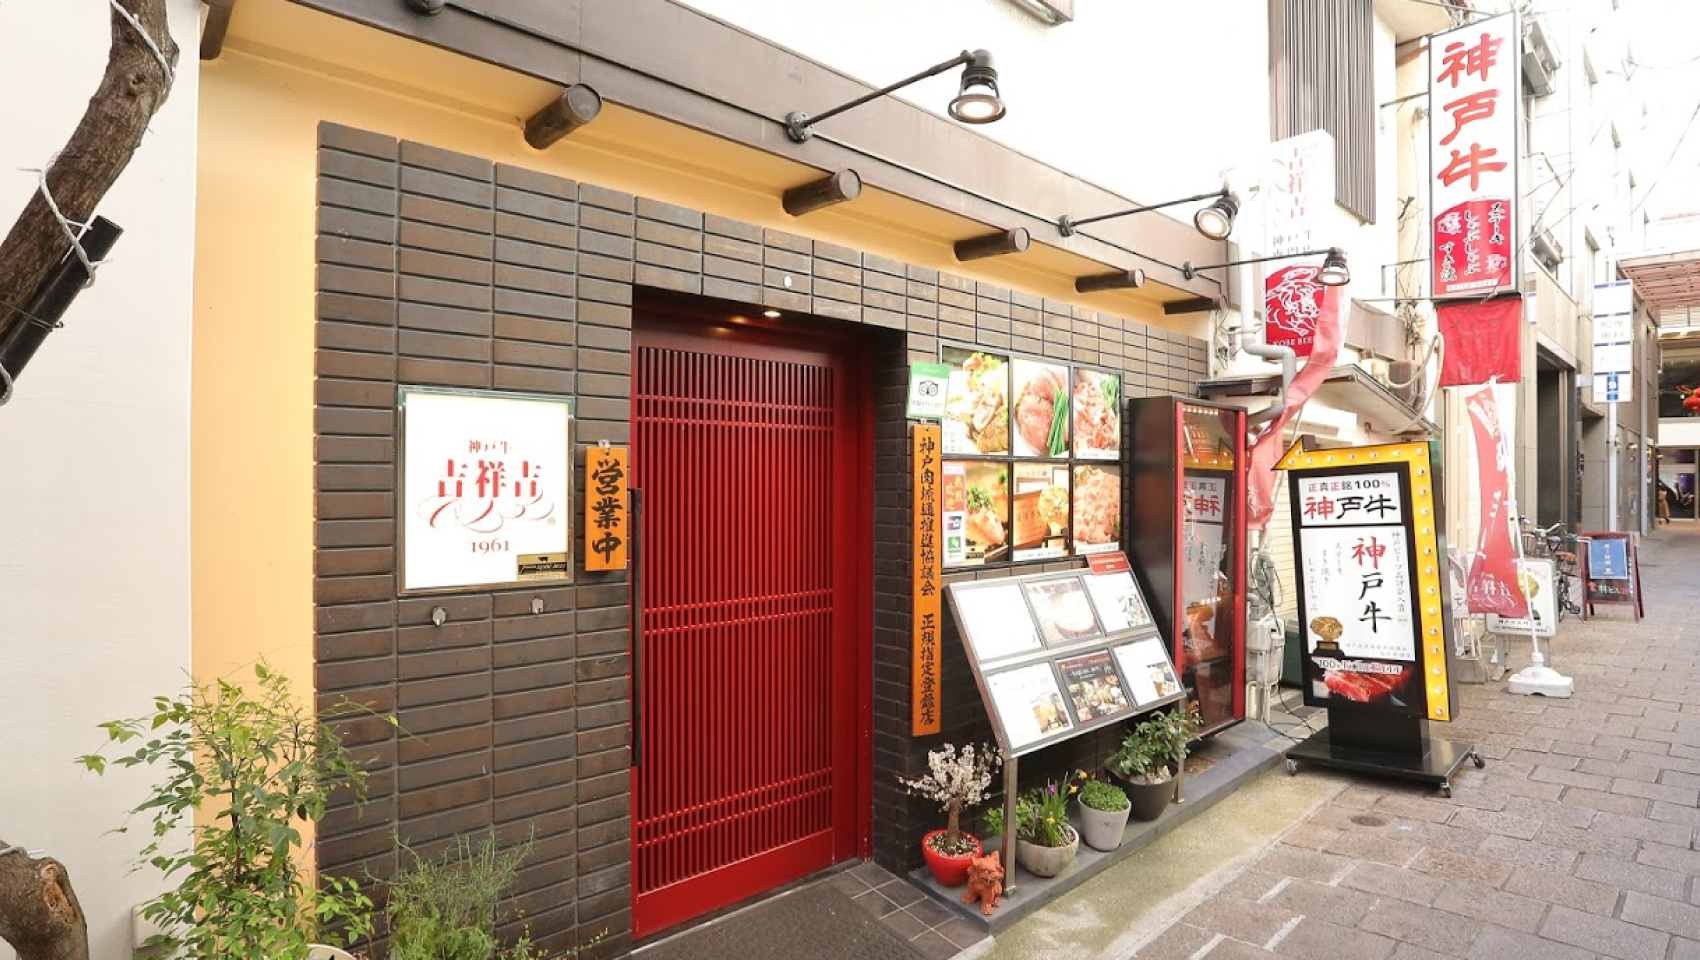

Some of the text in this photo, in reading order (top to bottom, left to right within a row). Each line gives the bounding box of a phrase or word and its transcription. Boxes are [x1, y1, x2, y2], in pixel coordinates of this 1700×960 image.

[1436, 32, 1508, 192] 神戸牛
[470, 540, 510, 555] 1961
[591, 458, 624, 565] 営業中
[1303, 494, 1397, 520] 神戸牛
[1351, 536, 1393, 634] 神戸牛
